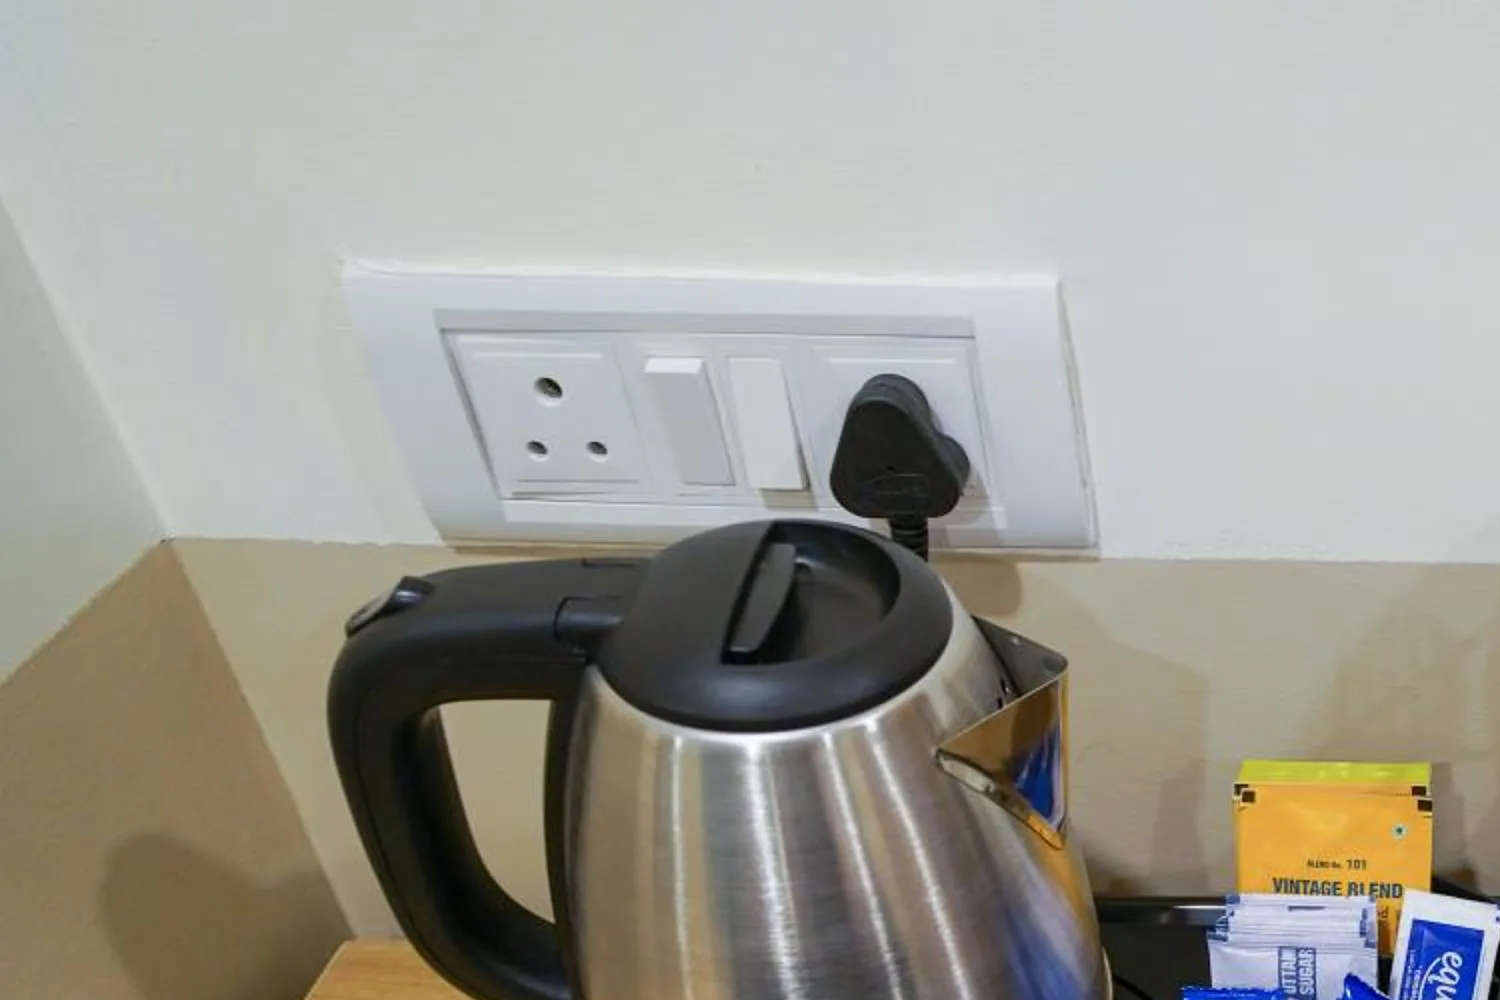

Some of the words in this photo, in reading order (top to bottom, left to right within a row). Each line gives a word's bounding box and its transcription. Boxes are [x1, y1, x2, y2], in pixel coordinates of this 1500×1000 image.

[1346, 859, 1367, 870] 101
[1272, 877, 1342, 896] VINTAGE
[1347, 882, 1403, 898] BLEND
[1299, 949, 1315, 995] SUGAR
